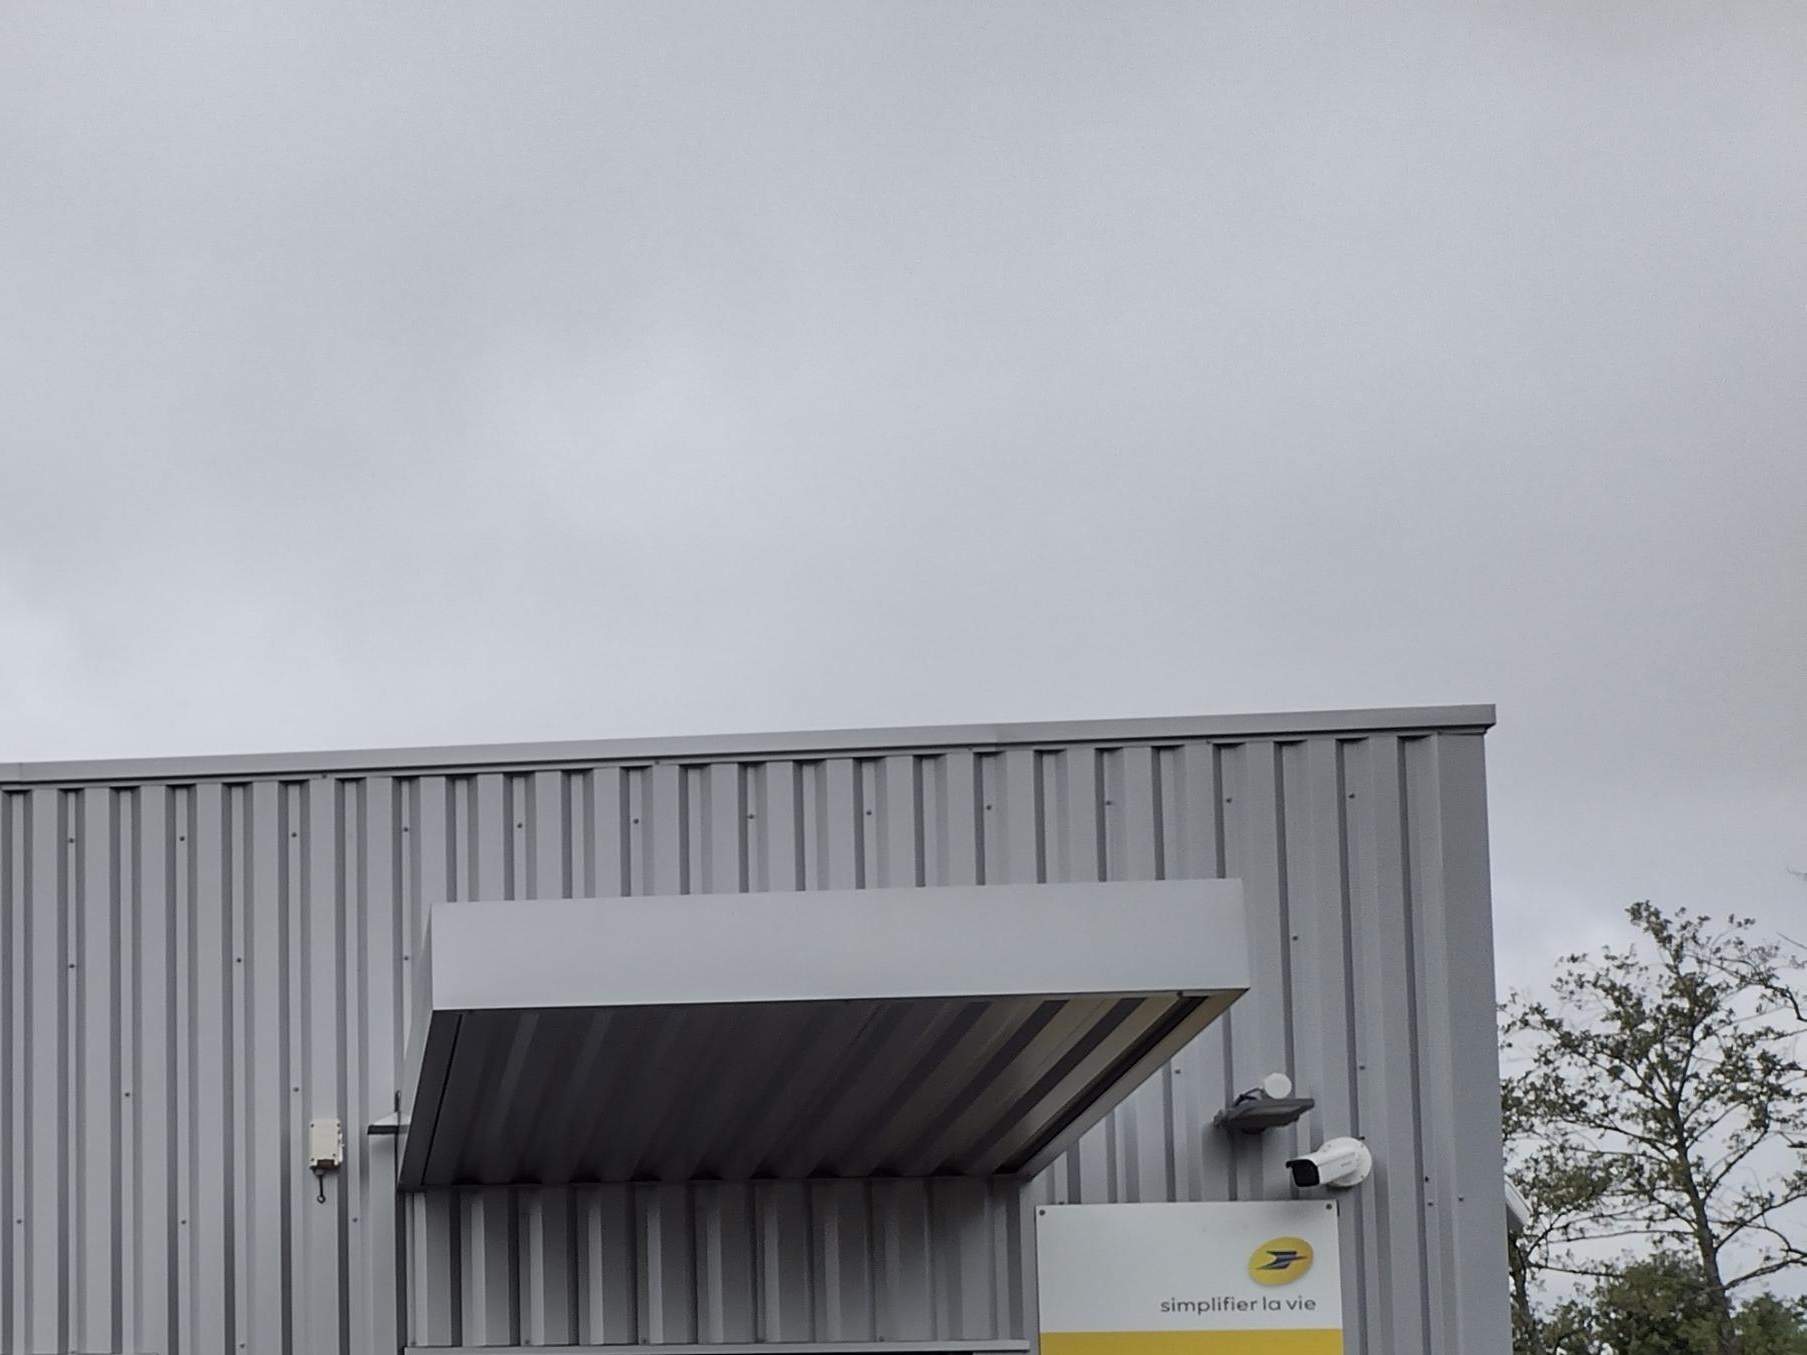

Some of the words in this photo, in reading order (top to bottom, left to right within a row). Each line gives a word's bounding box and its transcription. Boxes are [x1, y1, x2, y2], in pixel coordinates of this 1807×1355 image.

[1160, 1296, 1257, 1315] simplifier
[1262, 1296, 1281, 1311] la
[1288, 1295, 1316, 1311] vie
